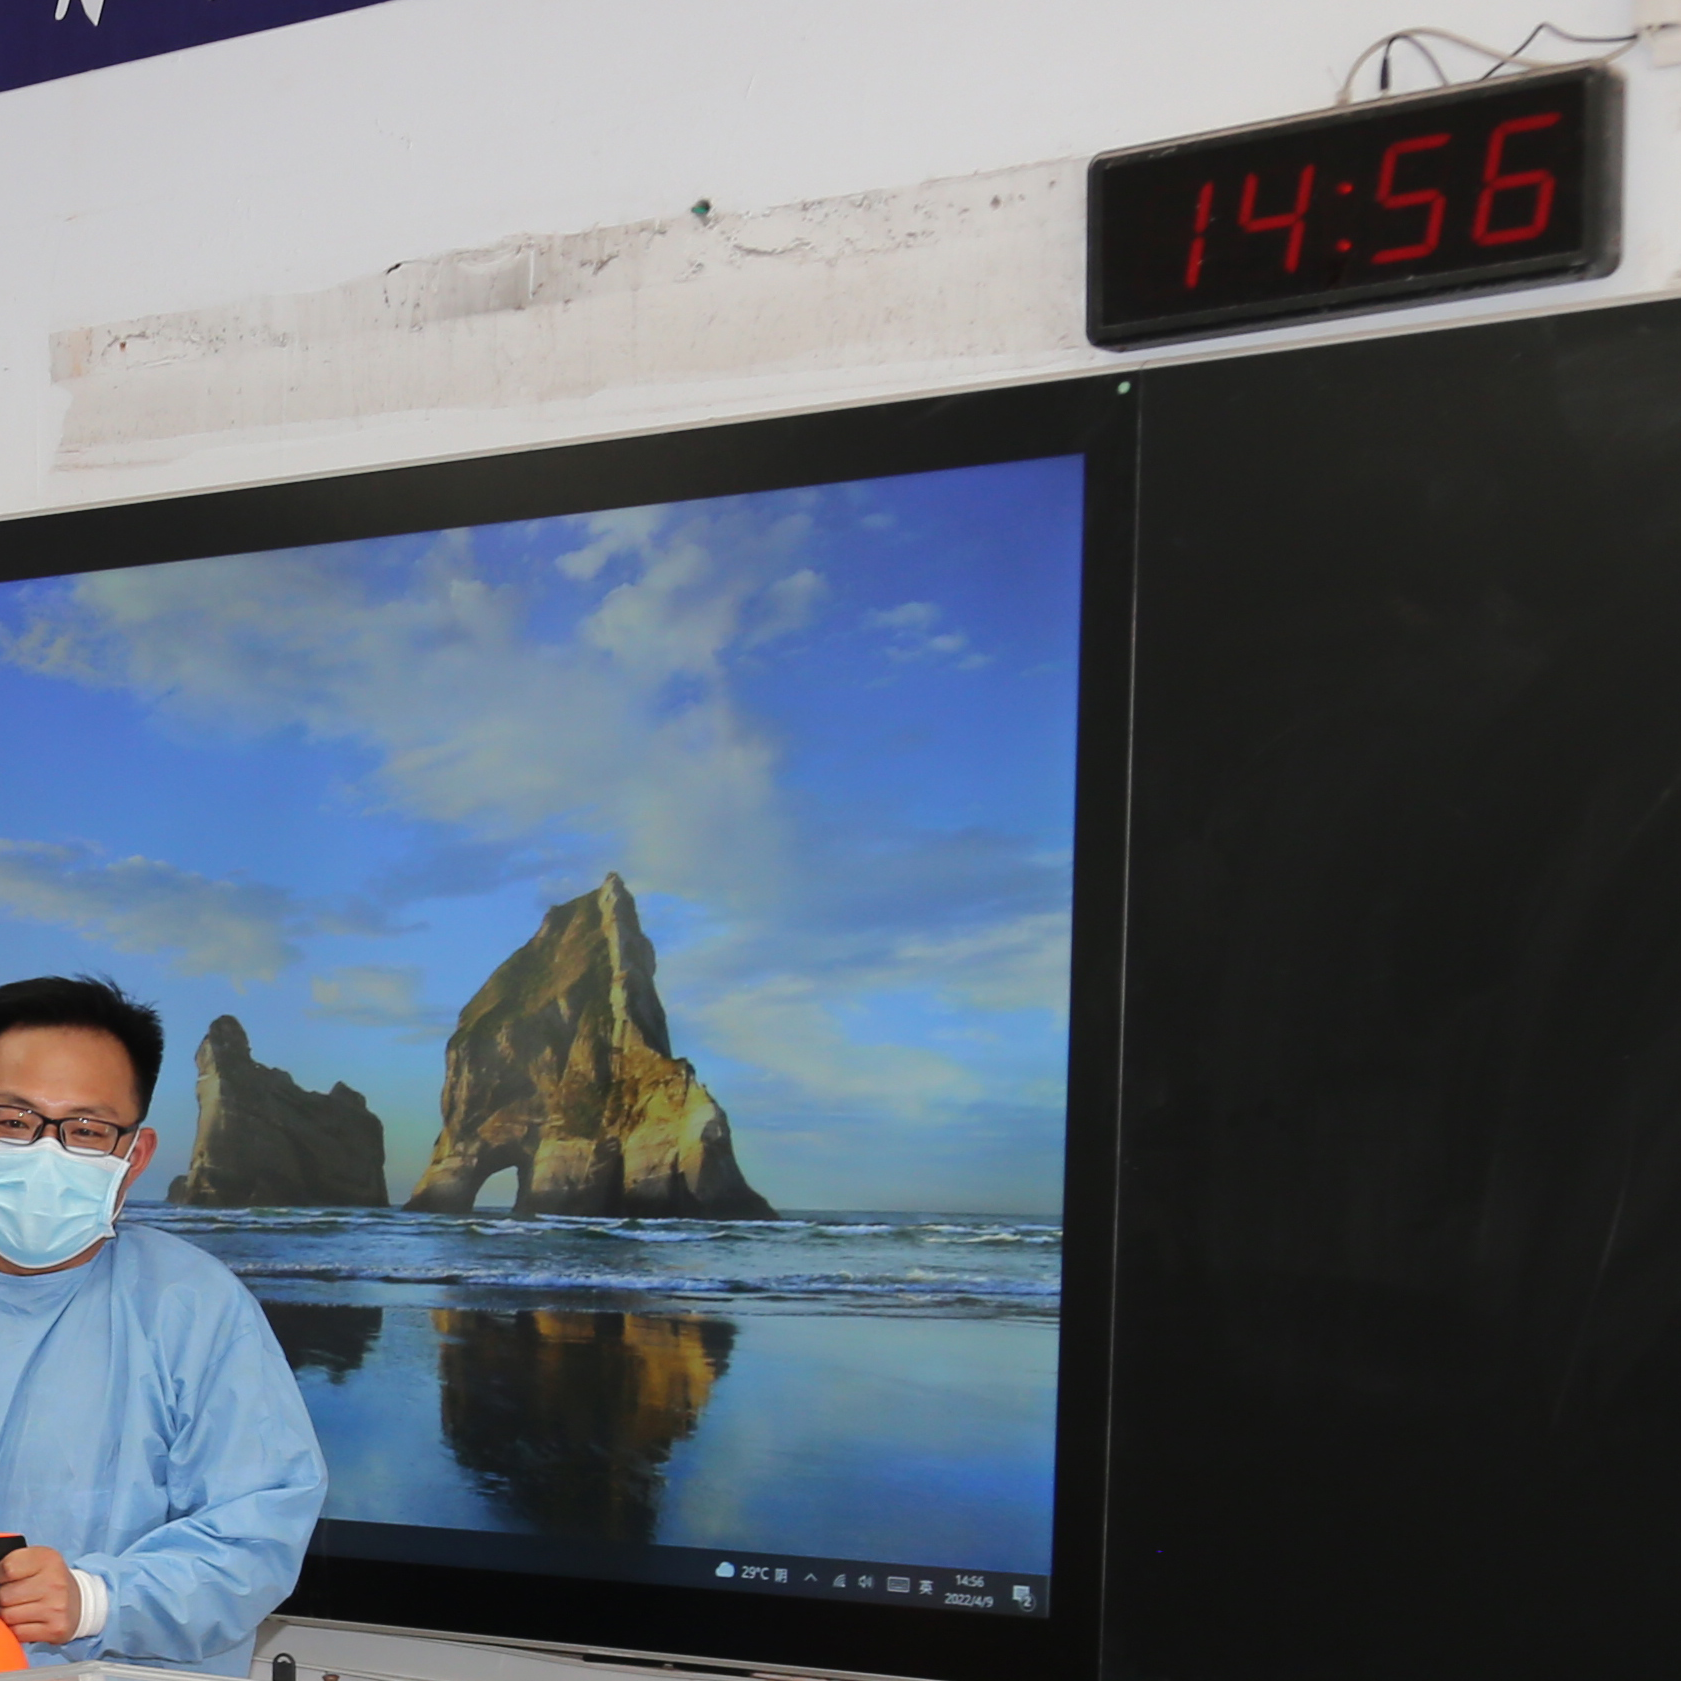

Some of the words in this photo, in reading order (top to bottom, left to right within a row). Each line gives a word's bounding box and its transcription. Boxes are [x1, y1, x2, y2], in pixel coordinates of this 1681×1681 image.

[1184, 112, 1562, 289] 14:56
[740, 1565, 769, 1581] 29°C
[955, 1573, 985, 1588] 14:56
[919, 1579, 934, 1595] 英
[944, 1592, 994, 1609] 2022/4/9
